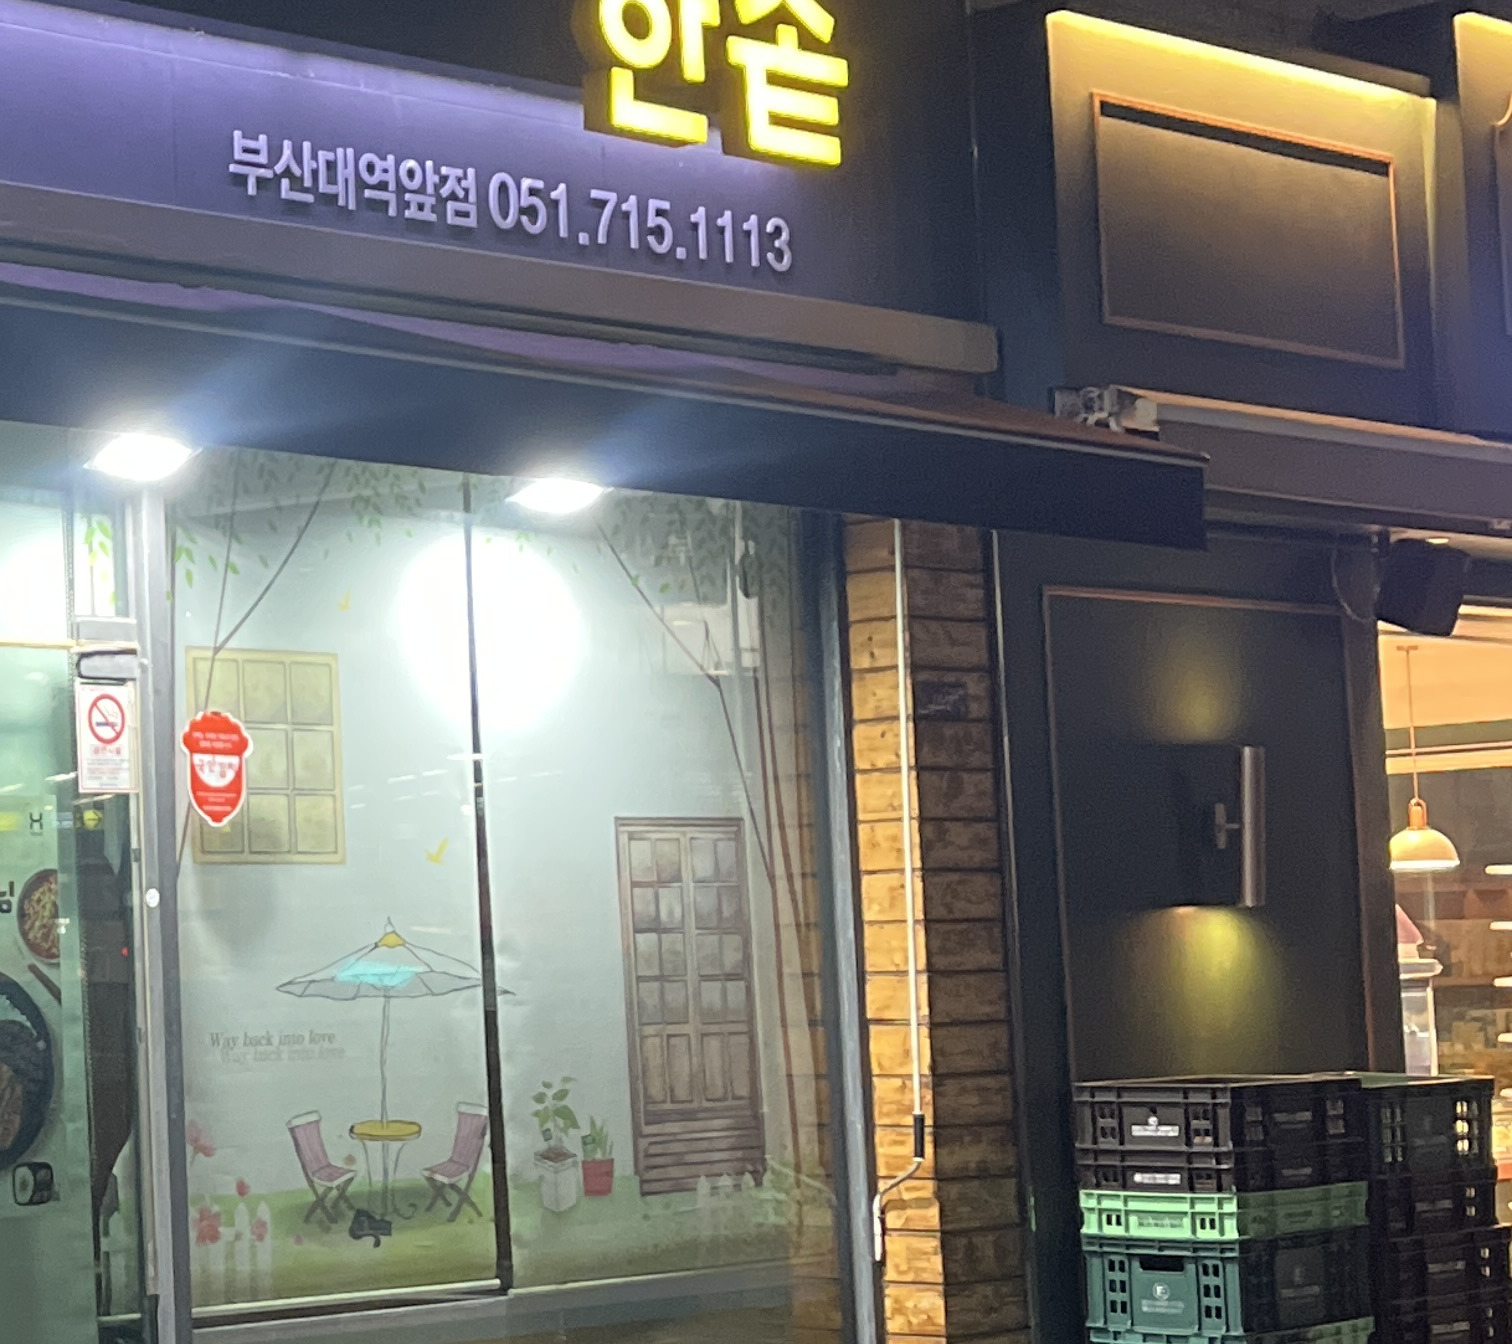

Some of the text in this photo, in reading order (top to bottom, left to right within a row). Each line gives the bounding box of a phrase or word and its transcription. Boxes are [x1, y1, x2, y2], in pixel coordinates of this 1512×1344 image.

[228, 129, 792, 273] 부산대역앞점 051.715.1113
[208, 1032, 238, 1051] Way
[309, 1029, 335, 1045] love
